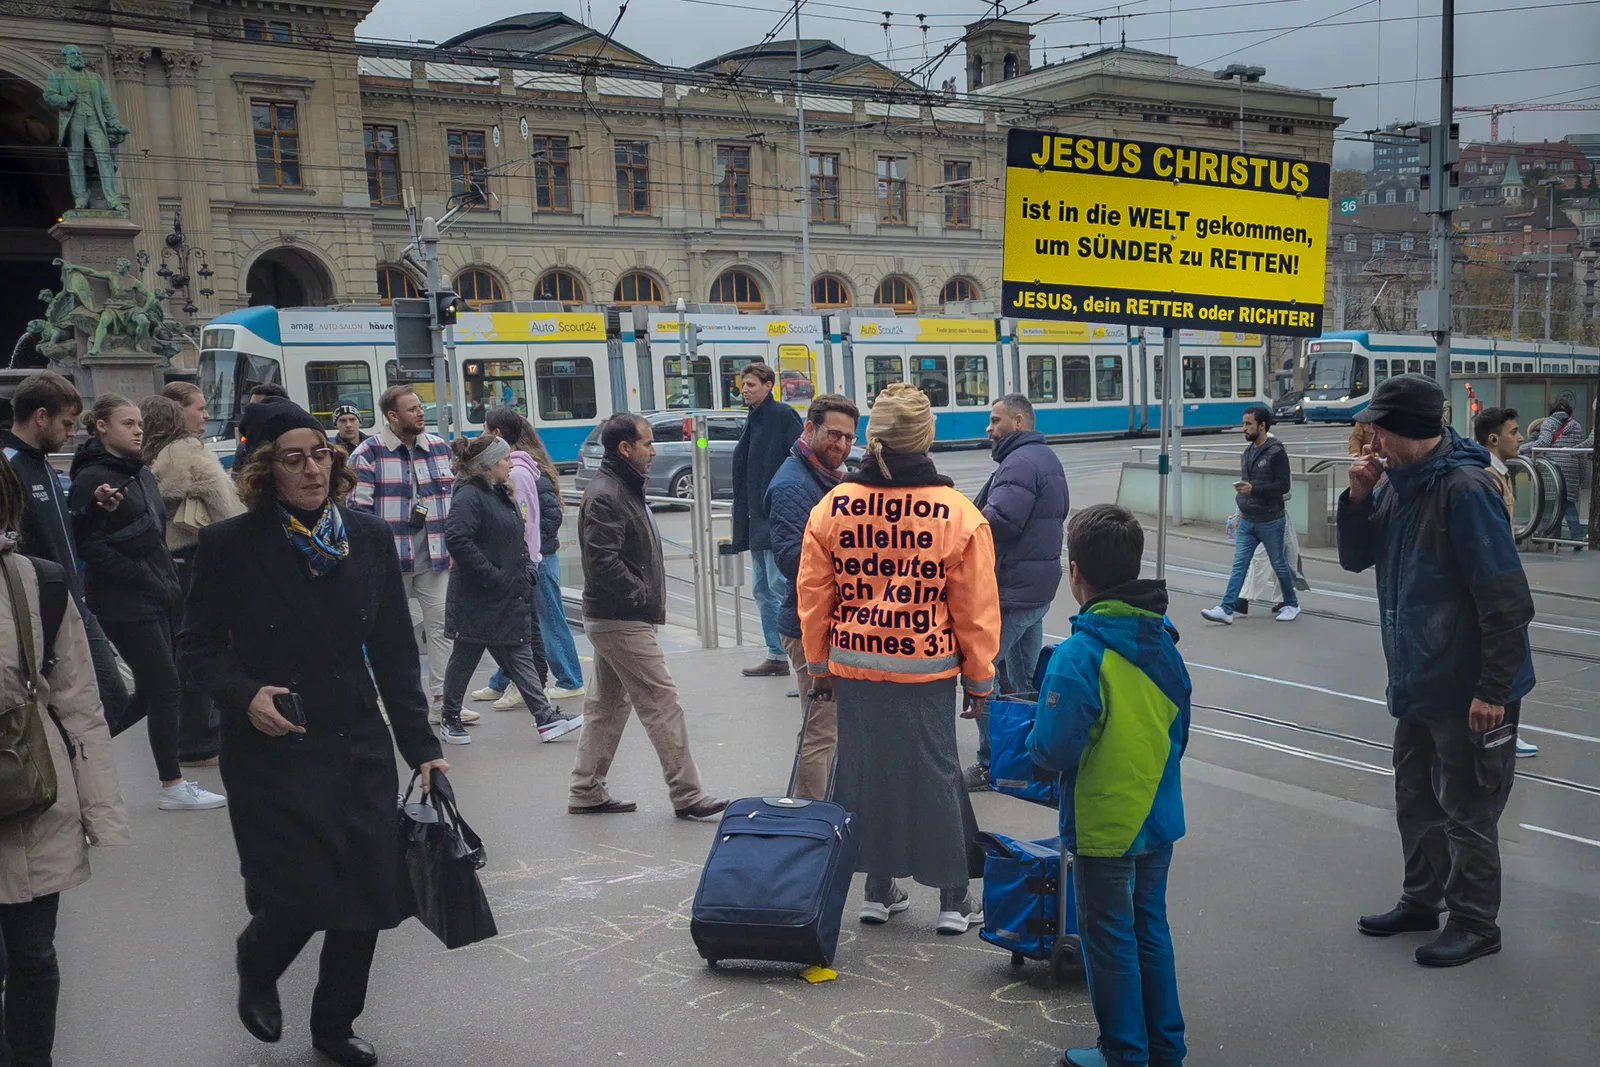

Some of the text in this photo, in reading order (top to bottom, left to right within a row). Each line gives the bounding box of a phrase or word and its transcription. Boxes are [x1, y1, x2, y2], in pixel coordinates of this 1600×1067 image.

[1031, 135, 1310, 192] JESUS CHRISTUS
[1341, 200, 1356, 212] 36
[1022, 197, 1314, 248] ist in die WELT gekommen,
[1035, 233, 1300, 275] um SÜNDER zu RETTEN!
[1012, 290, 1315, 328] JESUS, dein RETTER oder RICHTER!
[290, 323, 314, 332] amag
[531, 322, 598, 332] Auto Scout24
[768, 324, 818, 333] Auto Scout24
[860, 325, 903, 335] Auto Scout24
[467, 364, 477, 373] 17
[831, 493, 950, 522] Religion
[839, 524, 933, 549] alleine
